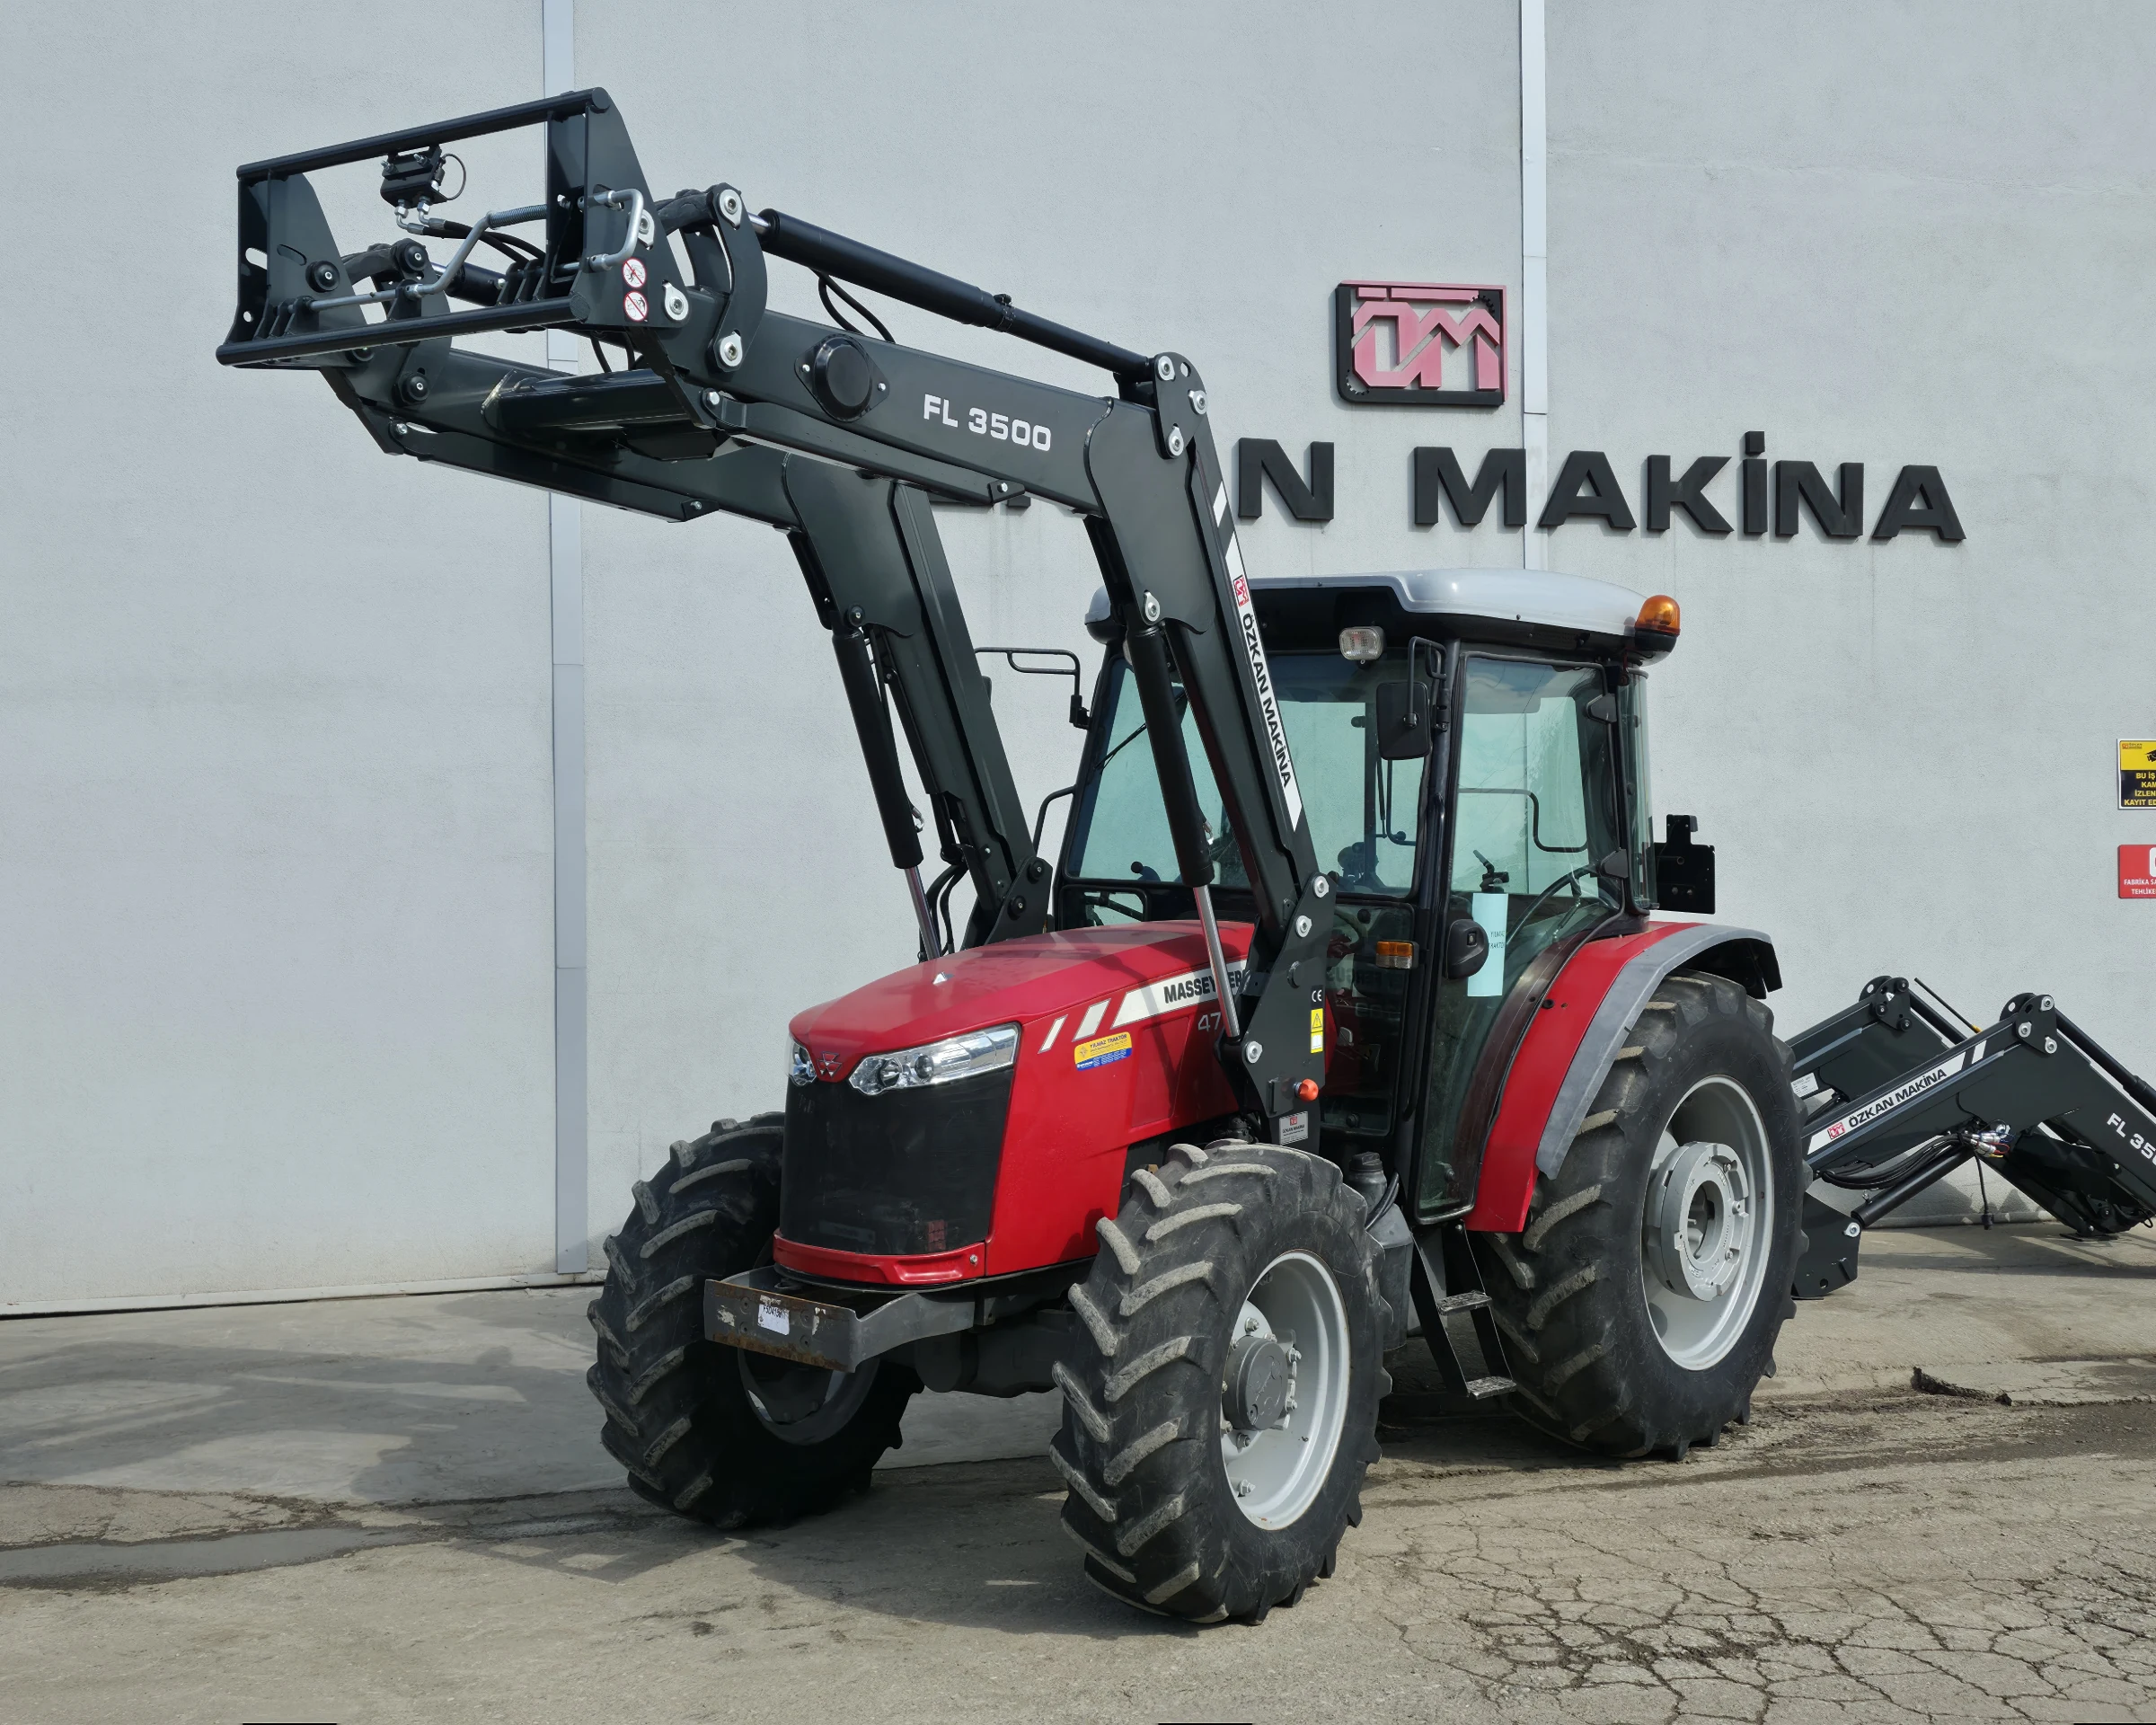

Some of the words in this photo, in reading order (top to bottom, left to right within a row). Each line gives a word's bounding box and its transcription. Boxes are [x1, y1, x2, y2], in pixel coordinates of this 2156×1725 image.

[923, 394, 959, 428] FL
[968, 407, 1051, 452] 3500
[1414, 429, 1966, 541] MAKİNA
[1242, 613, 1268, 695] ÖZKAN
[1263, 696, 1292, 788] MAKİNA
[1163, 975, 1216, 1004] MASSEY
[1197, 1012, 1222, 1032] 47
[1848, 1097, 1895, 1128] ÖZKAN
[1895, 1068, 1948, 1102] MAKİNA
[2107, 1112, 2126, 1138] FL
